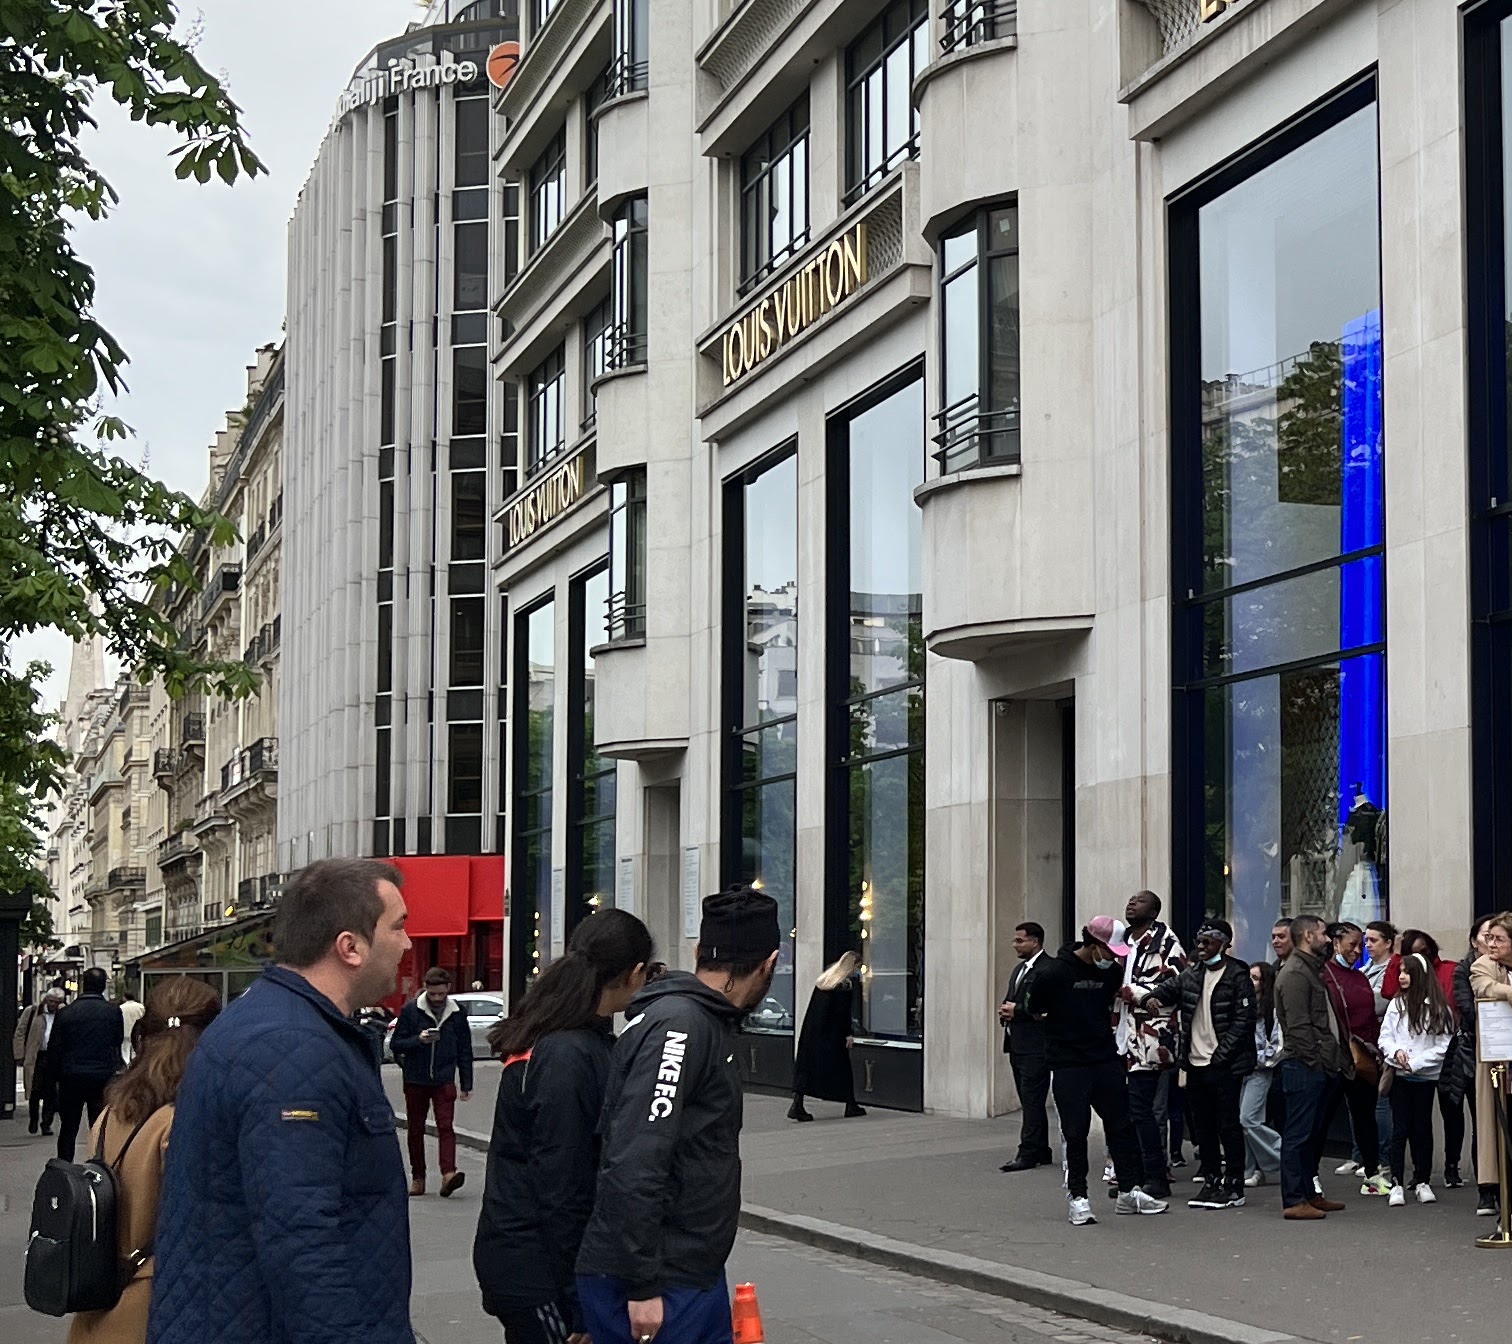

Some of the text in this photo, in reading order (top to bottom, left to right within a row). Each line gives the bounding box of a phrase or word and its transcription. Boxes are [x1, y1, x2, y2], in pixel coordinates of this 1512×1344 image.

[390, 60, 478, 93] France
[723, 223, 865, 387] LOUIS VUITTON
[509, 455, 582, 548] LOUIS VUITTON
[648, 1030, 688, 1122] NIKE F.C.
